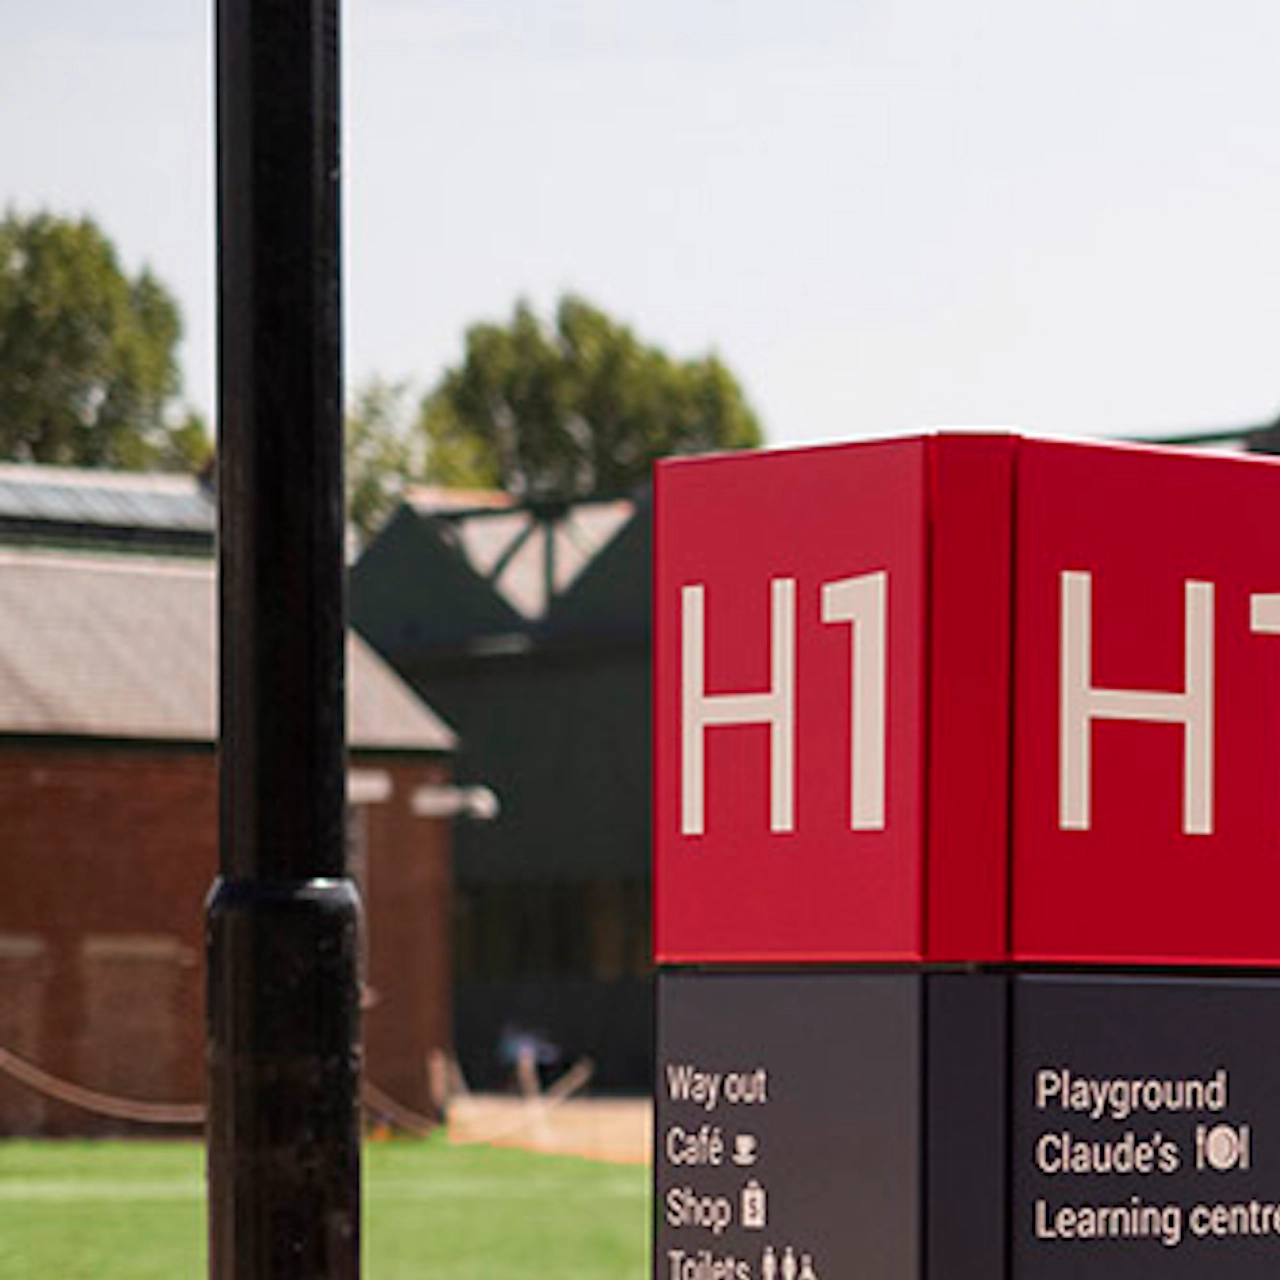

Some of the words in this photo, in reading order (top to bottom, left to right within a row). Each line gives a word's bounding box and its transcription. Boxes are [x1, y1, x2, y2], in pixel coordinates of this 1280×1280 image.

[681, 570, 888, 835] H1
[667, 1065, 720, 1111] Way
[724, 1069, 768, 1103] out
[1036, 1069, 1227, 1118] Playground
[667, 1125, 723, 1166] Café
[1036, 1131, 1180, 1173] Claude's
[667, 1187, 732, 1234] Shop
[1036, 1196, 1182, 1245] Learning
